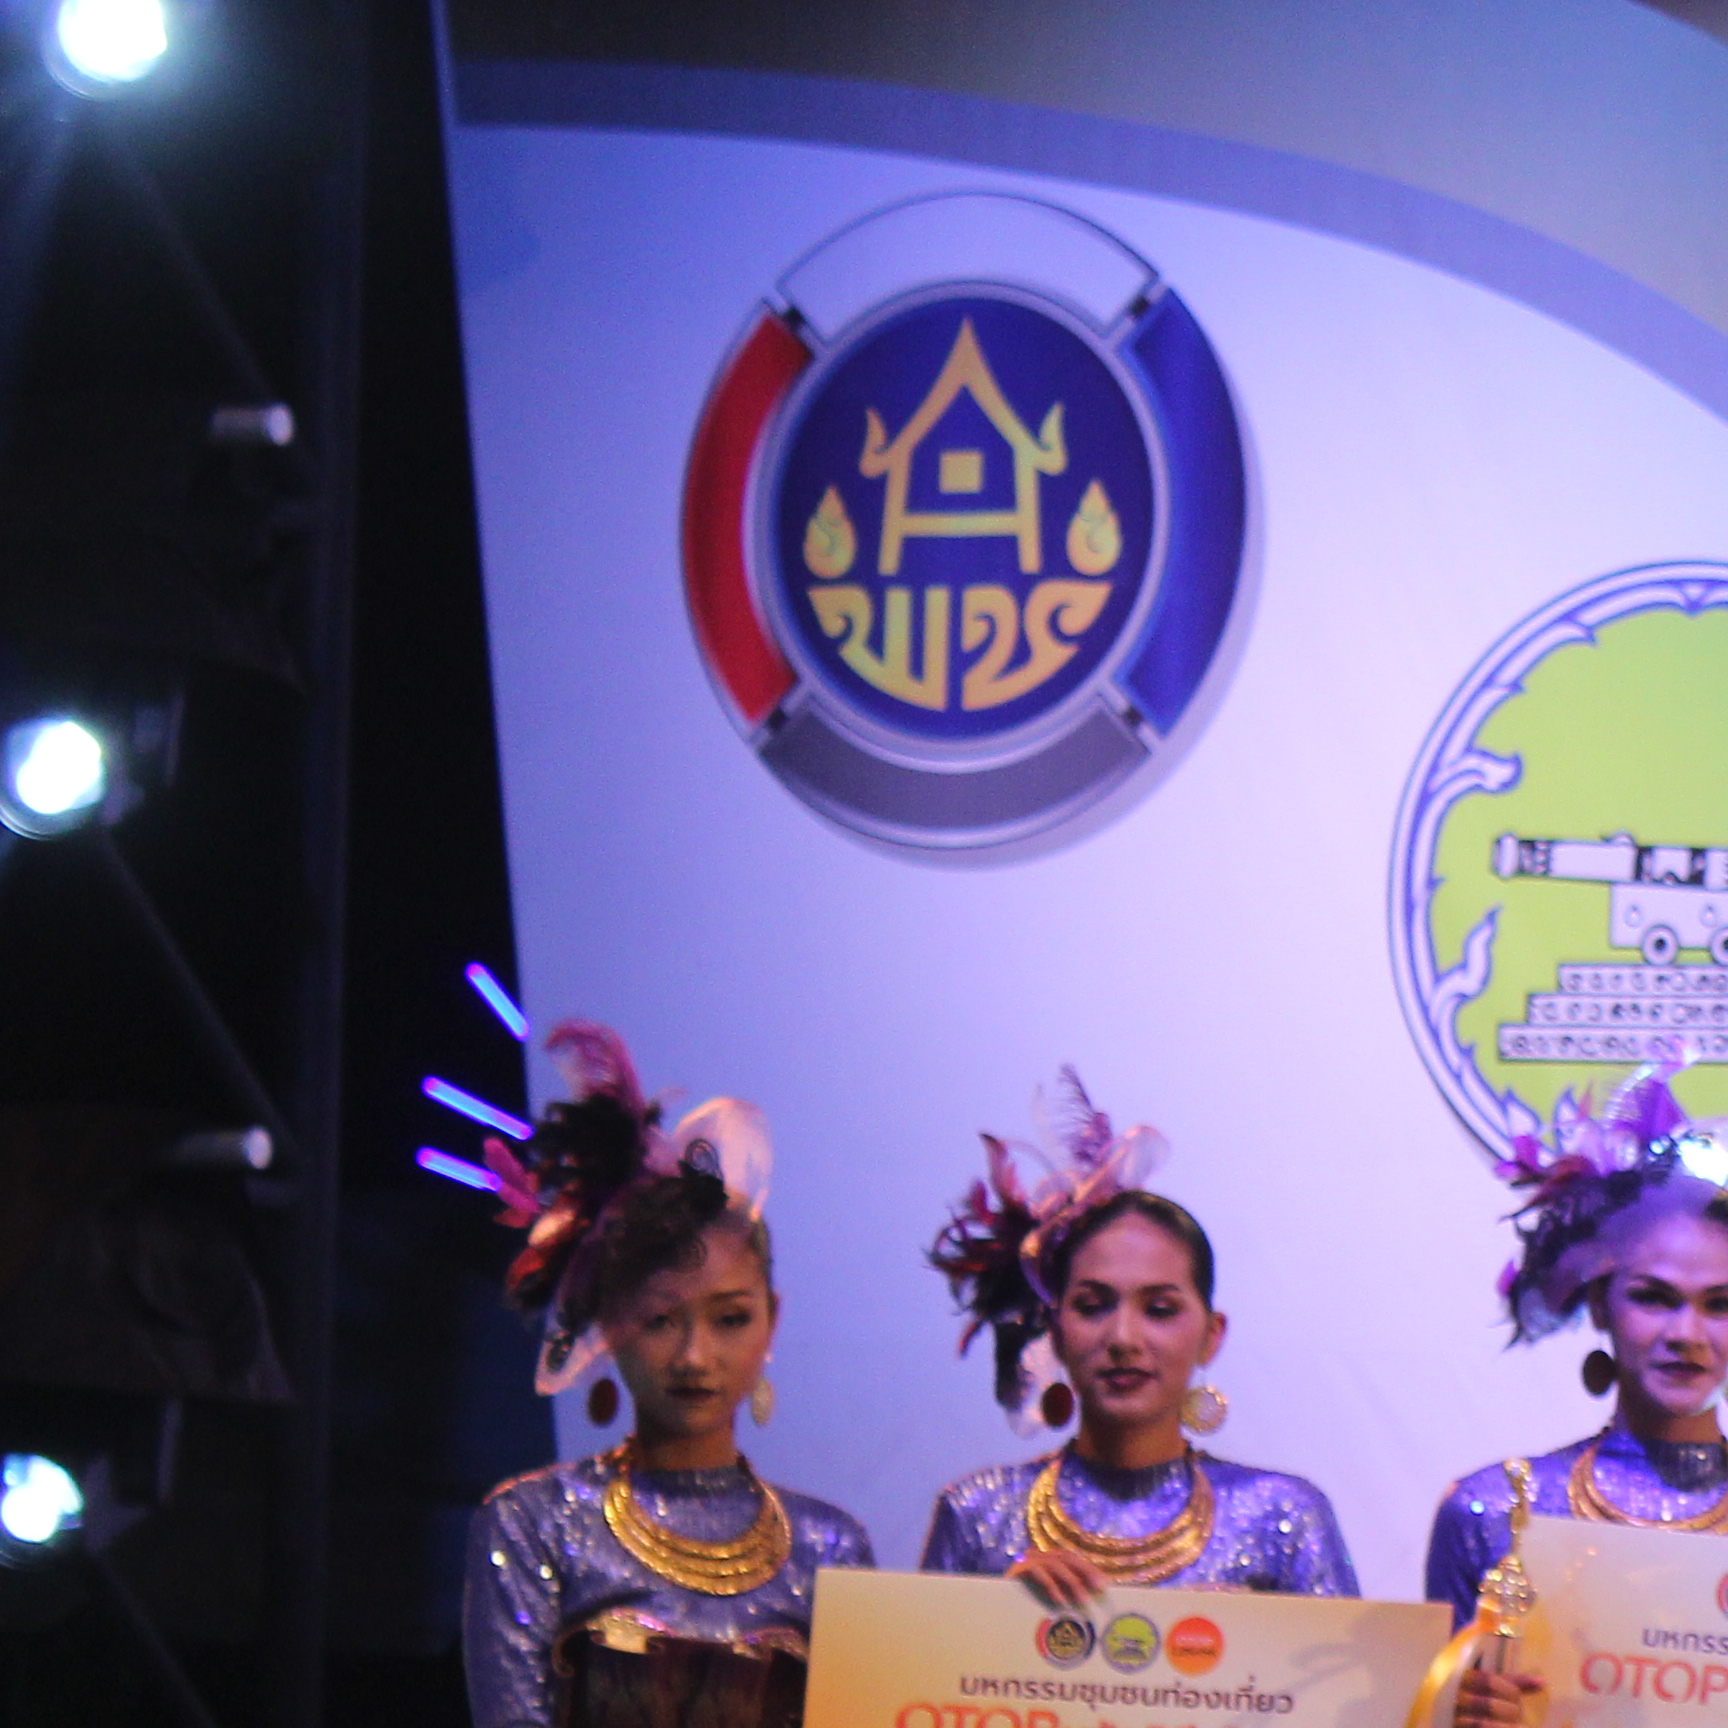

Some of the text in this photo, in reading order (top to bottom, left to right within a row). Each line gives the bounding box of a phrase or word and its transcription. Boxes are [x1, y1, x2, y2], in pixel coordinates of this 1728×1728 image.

[960, 1674, 1294, 1716] มหกรรมชุมชนท่องเที่ยว
